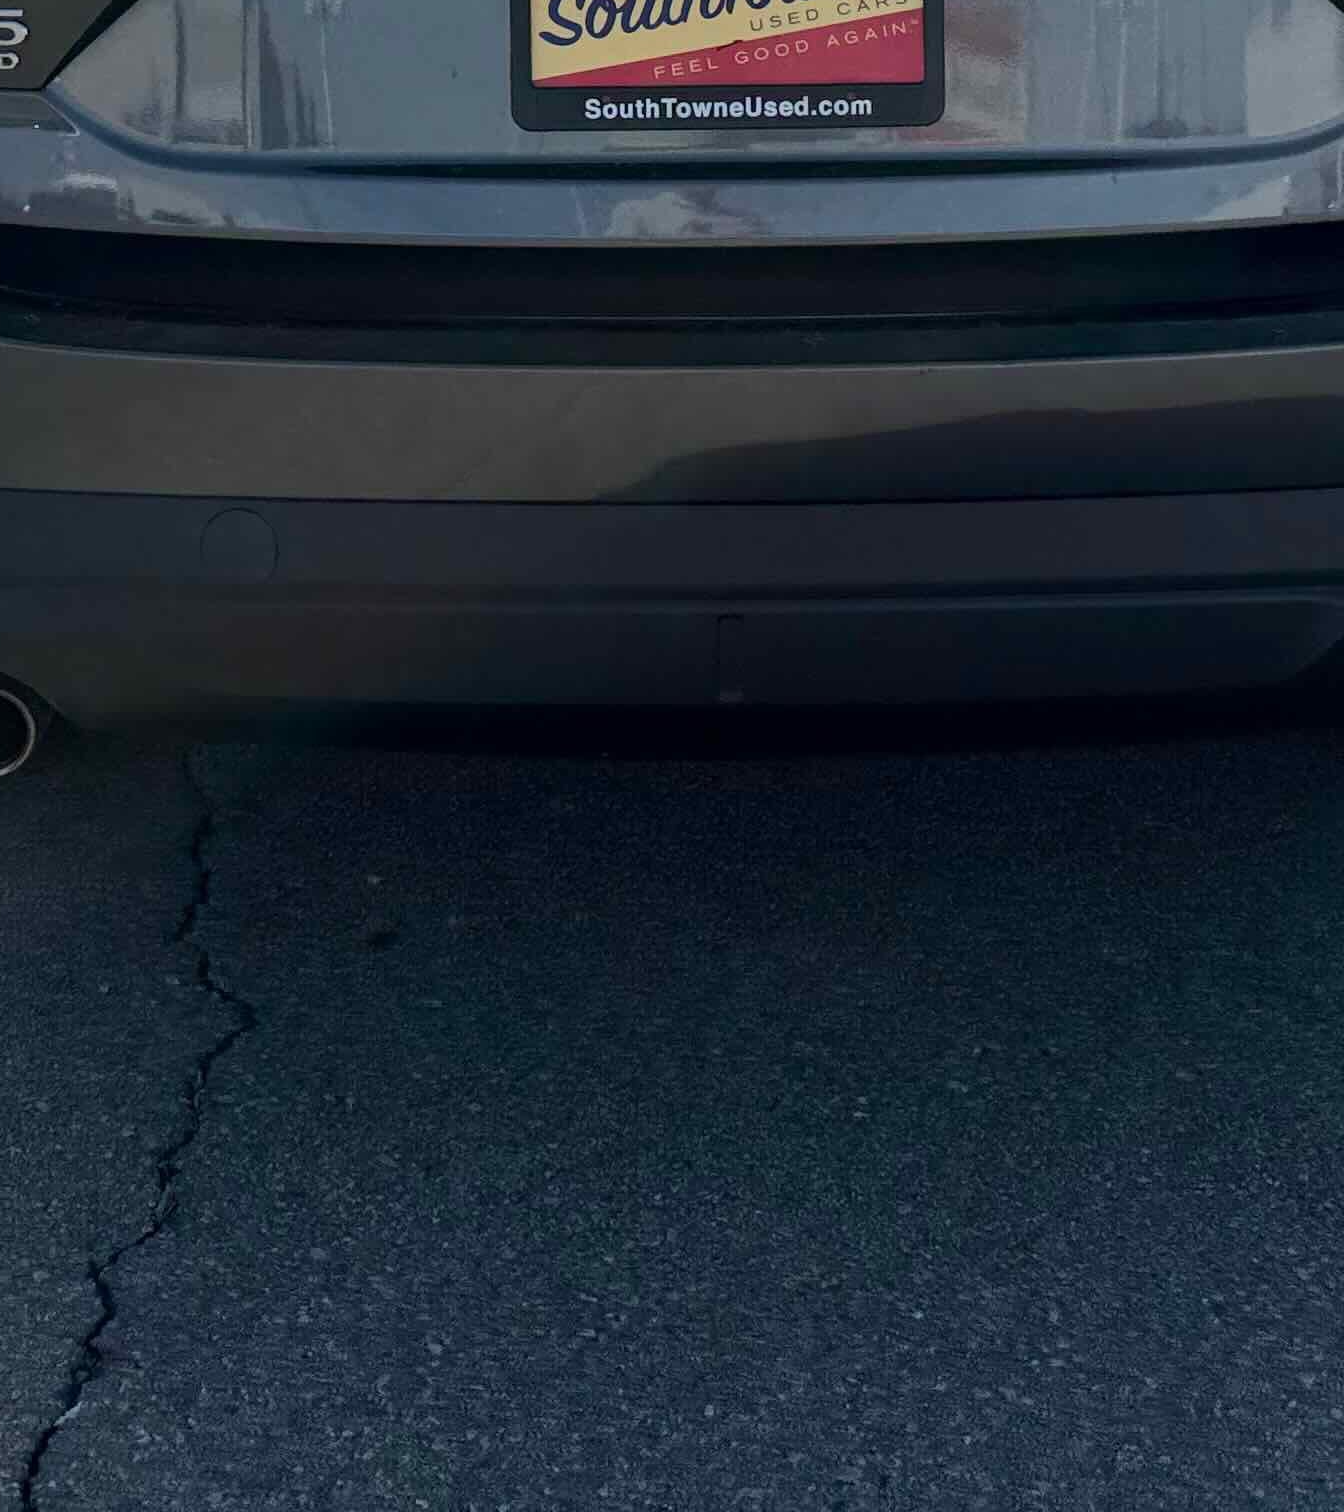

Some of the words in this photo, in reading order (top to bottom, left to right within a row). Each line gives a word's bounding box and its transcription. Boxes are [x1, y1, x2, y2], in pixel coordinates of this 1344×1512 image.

[749, 8, 820, 32] USED
[653, 57, 720, 80] FEEL
[735, 39, 810, 65] GOOD
[584, 97, 873, 120] SouthTowneUsed.com
